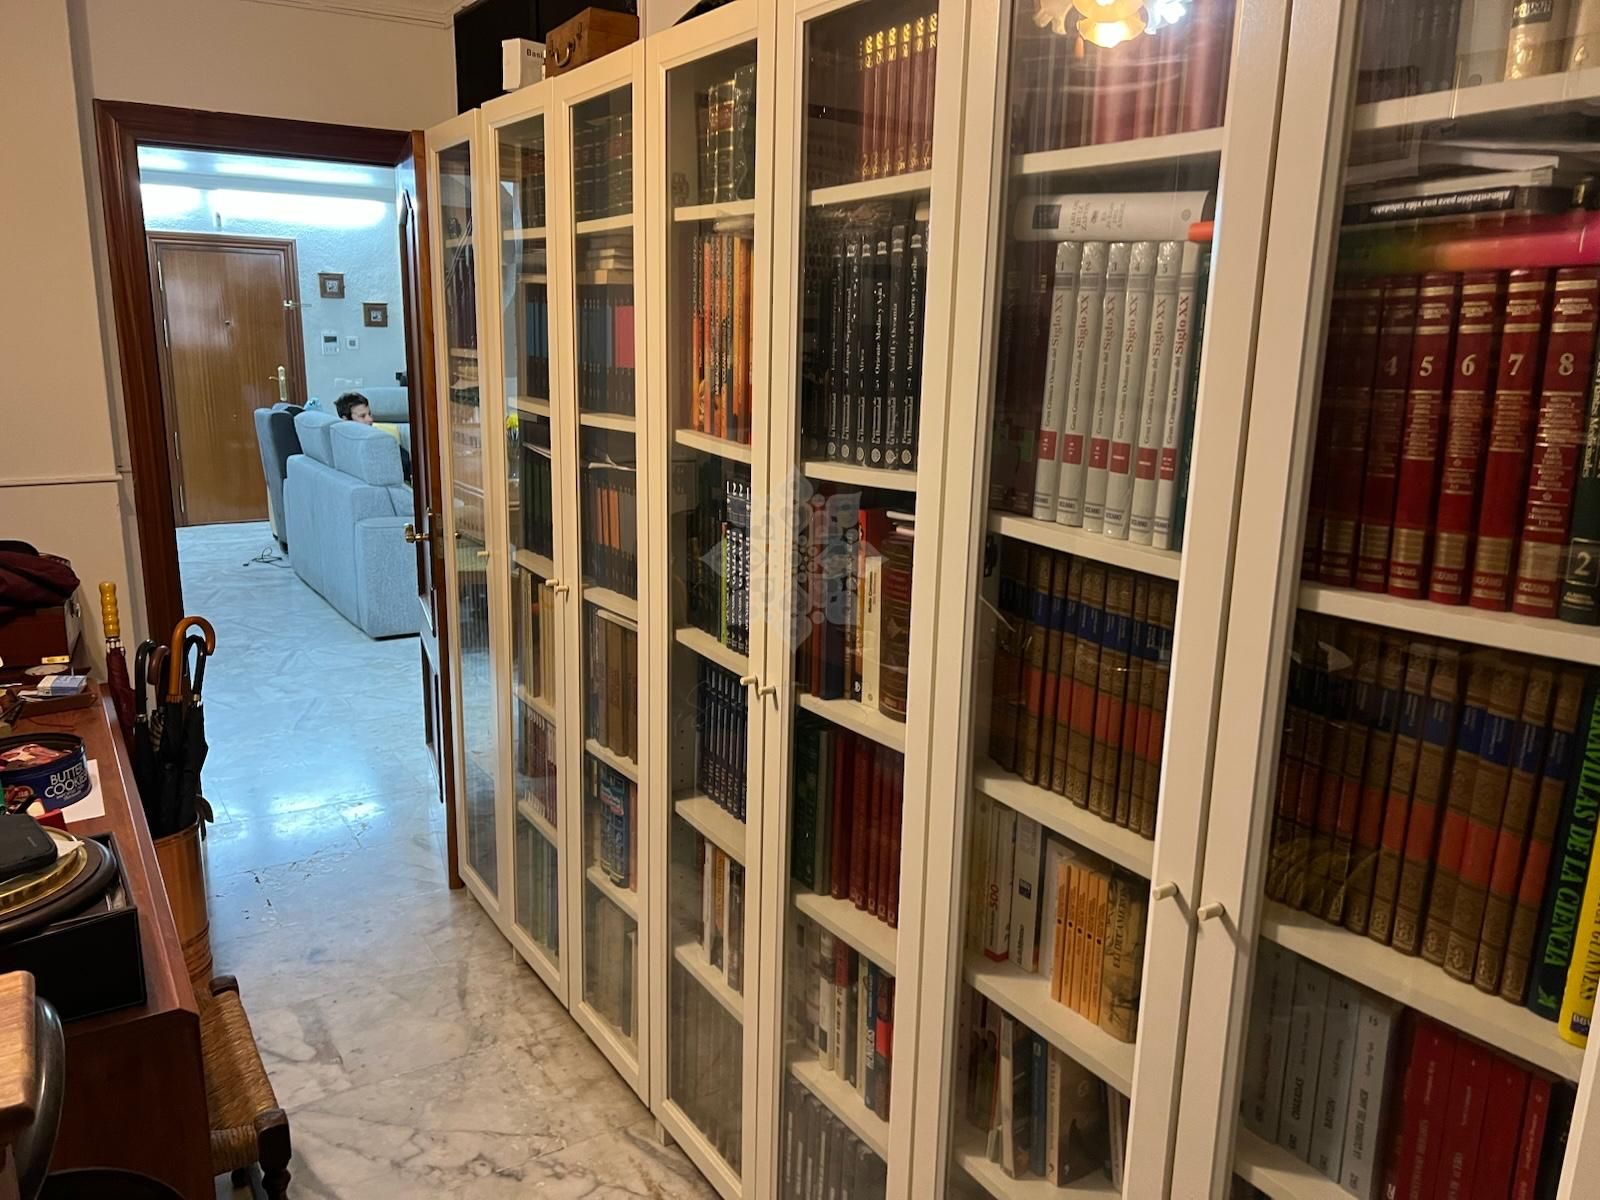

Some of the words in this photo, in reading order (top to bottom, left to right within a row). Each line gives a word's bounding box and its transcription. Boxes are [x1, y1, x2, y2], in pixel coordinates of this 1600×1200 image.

[1055, 294, 1064, 312] XX
[1080, 295, 1089, 314] XX
[1105, 296, 1115, 316] XX
[1128, 296, 1138, 316] XX
[1156, 297, 1166, 320] XX
[1179, 296, 1189, 317] XX
[1052, 315, 1064, 346] Siglo
[1077, 316, 1089, 349] Siglo
[1102, 318, 1114, 351] Siglo
[1126, 318, 1137, 352] Siglo
[1152, 322, 1164, 356] Siglo
[1175, 320, 1187, 354] Siglo
[1384, 355, 1398, 376] 4
[1419, 355, 1434, 377] 5
[1461, 353, 1477, 376] 6
[1508, 353, 1525, 376] 7
[1558, 352, 1574, 377] 8
[1582, 417, 1599, 478] Medicinales
[1574, 551, 1593, 576] 2
[1566, 823, 1594, 855] DE
[1560, 854, 1586, 883] LA
[989, 884, 999, 911] 500
[1544, 887, 1581, 966] CIENCIA
[1580, 931, 1600, 1001] GUINNESS
